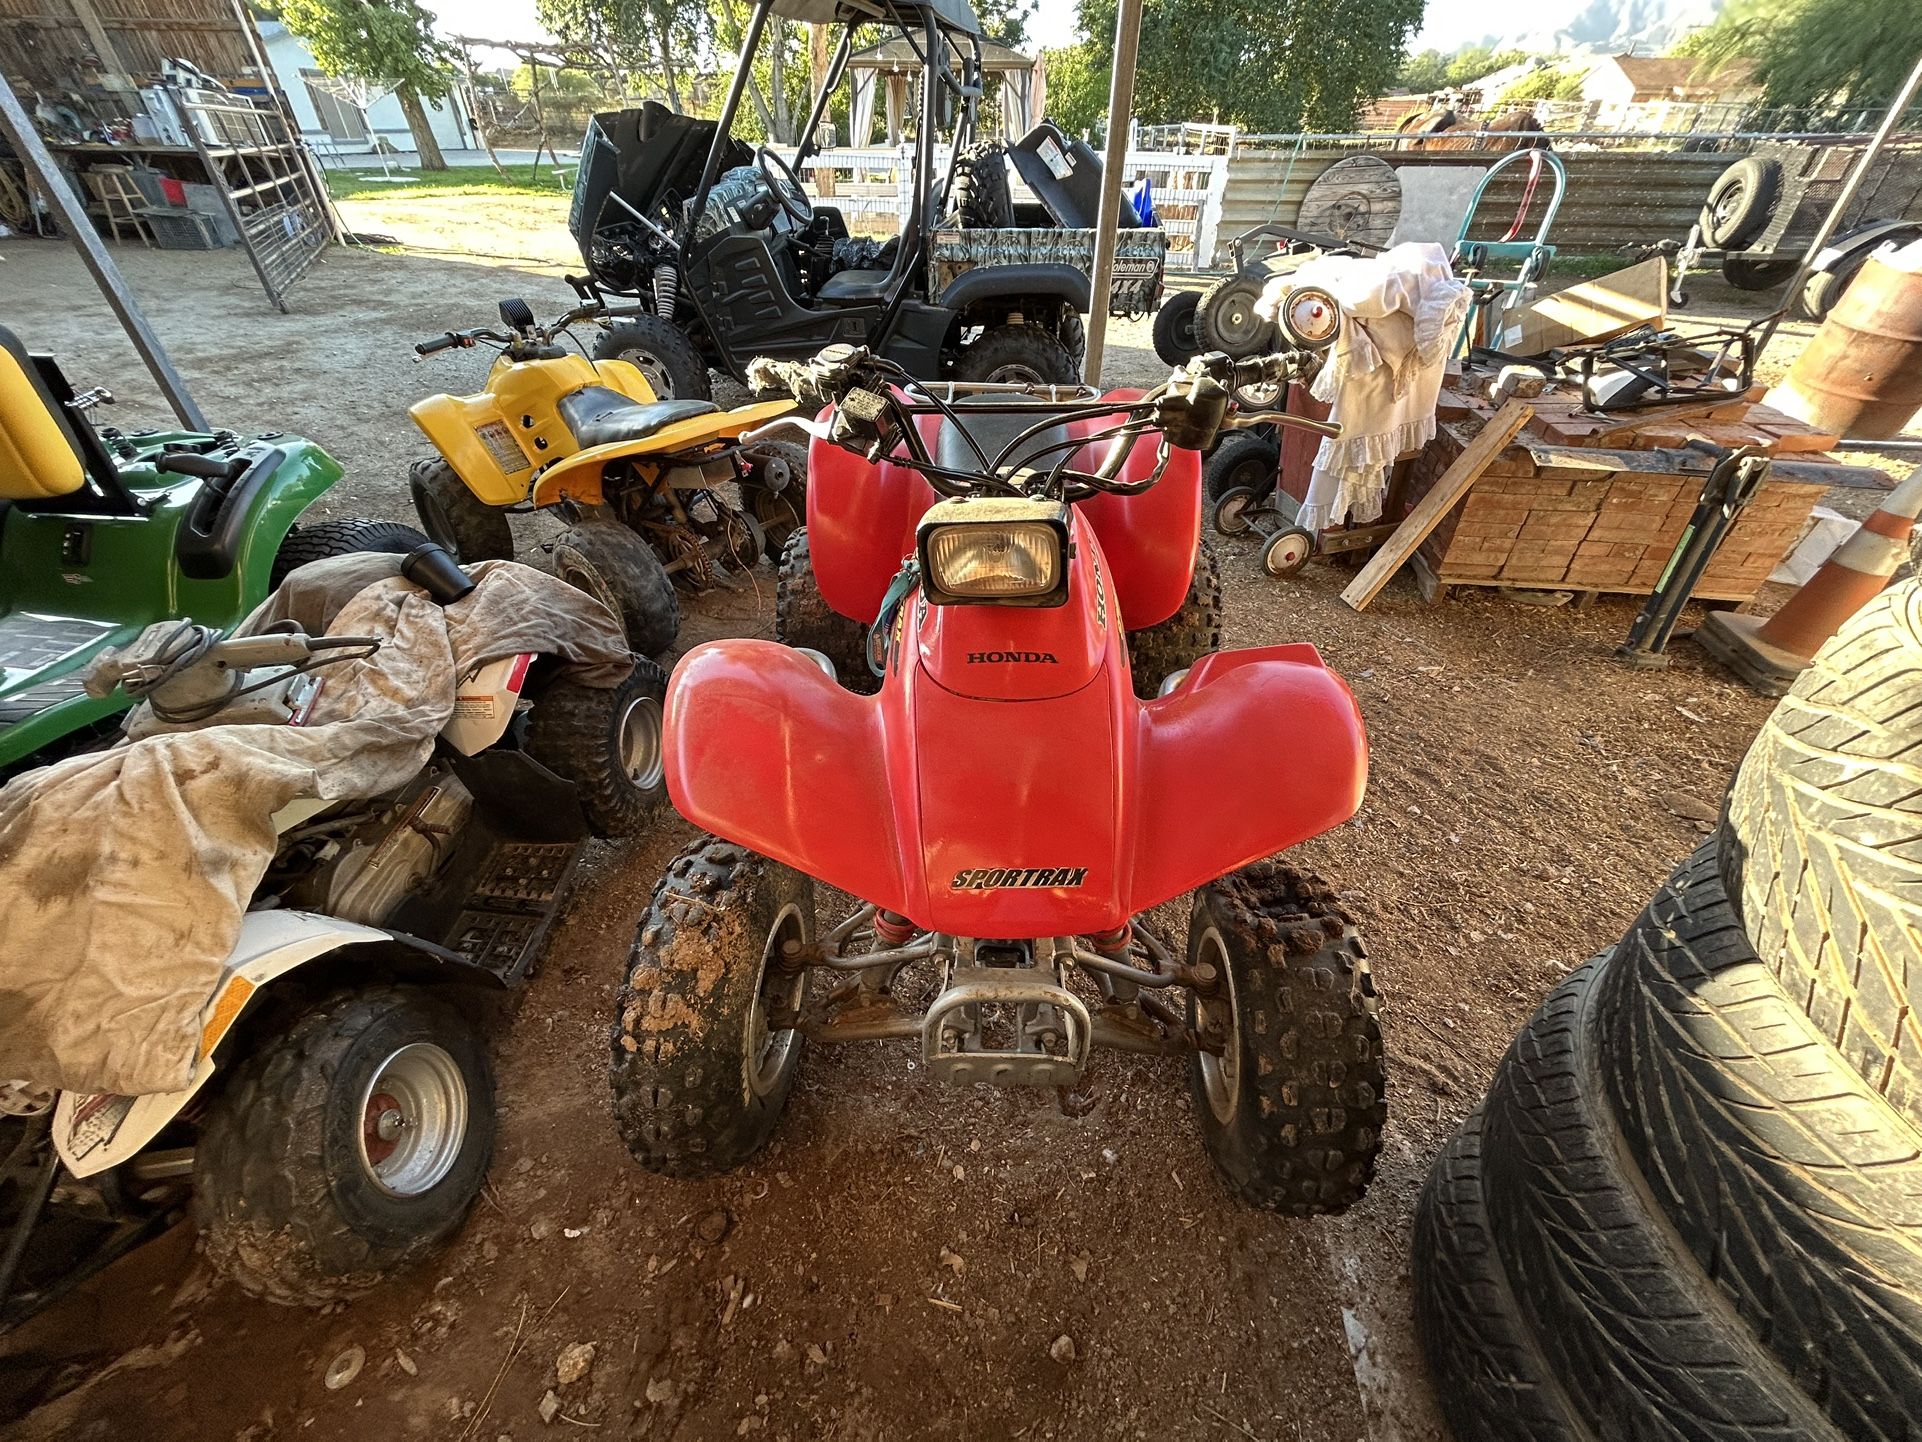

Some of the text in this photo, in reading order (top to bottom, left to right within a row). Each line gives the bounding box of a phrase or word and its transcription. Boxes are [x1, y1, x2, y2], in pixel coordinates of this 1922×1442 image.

[1111, 260, 1146, 272] oleman
[966, 652, 1059, 664] HONDA
[951, 867, 1088, 889] SPORTRAX
